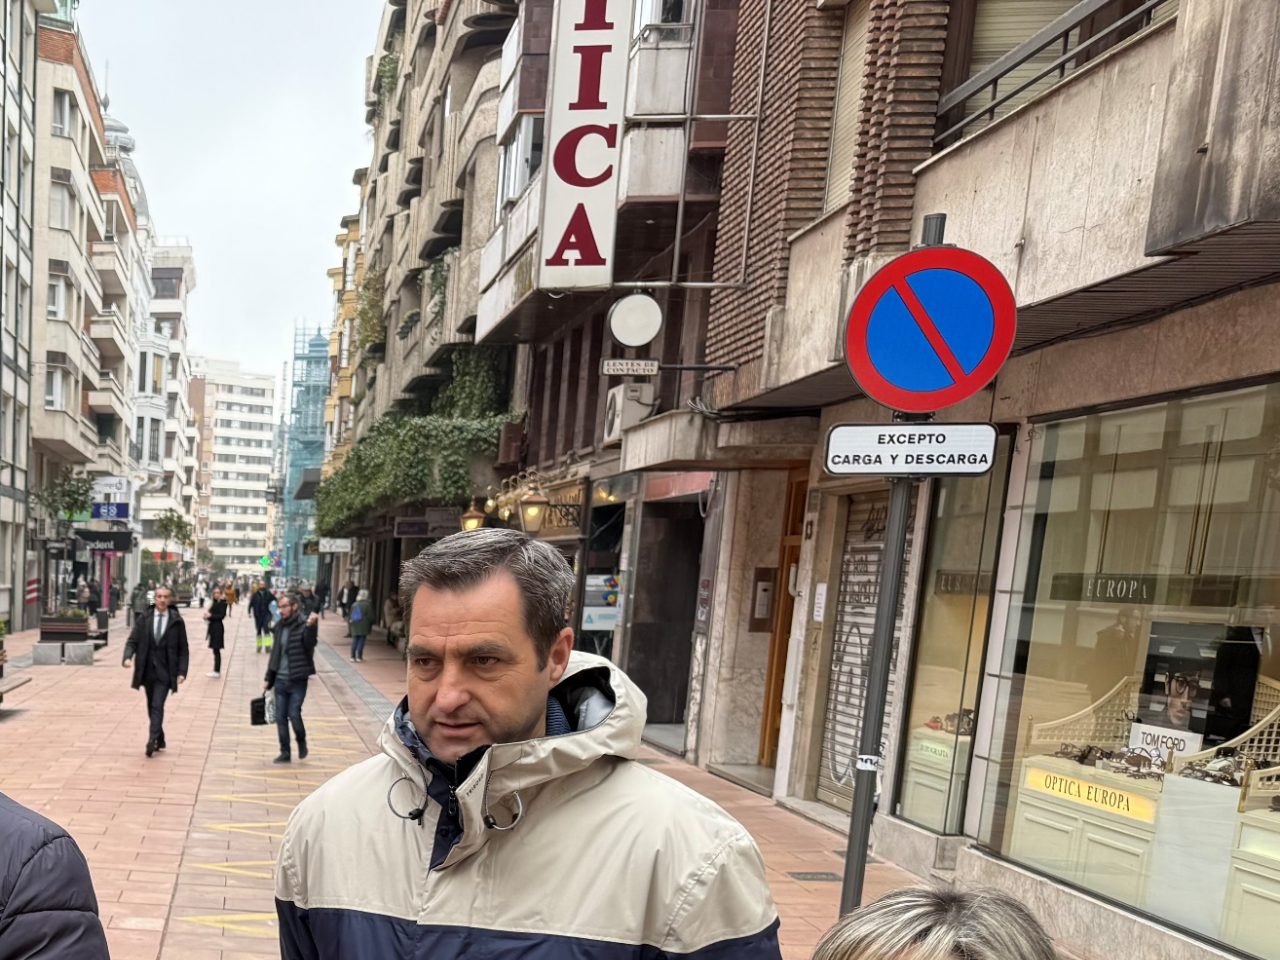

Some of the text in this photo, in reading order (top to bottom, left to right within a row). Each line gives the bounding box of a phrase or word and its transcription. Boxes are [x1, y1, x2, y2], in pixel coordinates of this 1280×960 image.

[877, 433, 946, 445] EXCEPTO
[831, 453, 989, 465] CARGA Y DESCARGA
[1086, 578, 1149, 599] EUROPA
[1141, 731, 1186, 752] TOM FORD
[1044, 774, 1131, 812] OPTICA EUROPA
